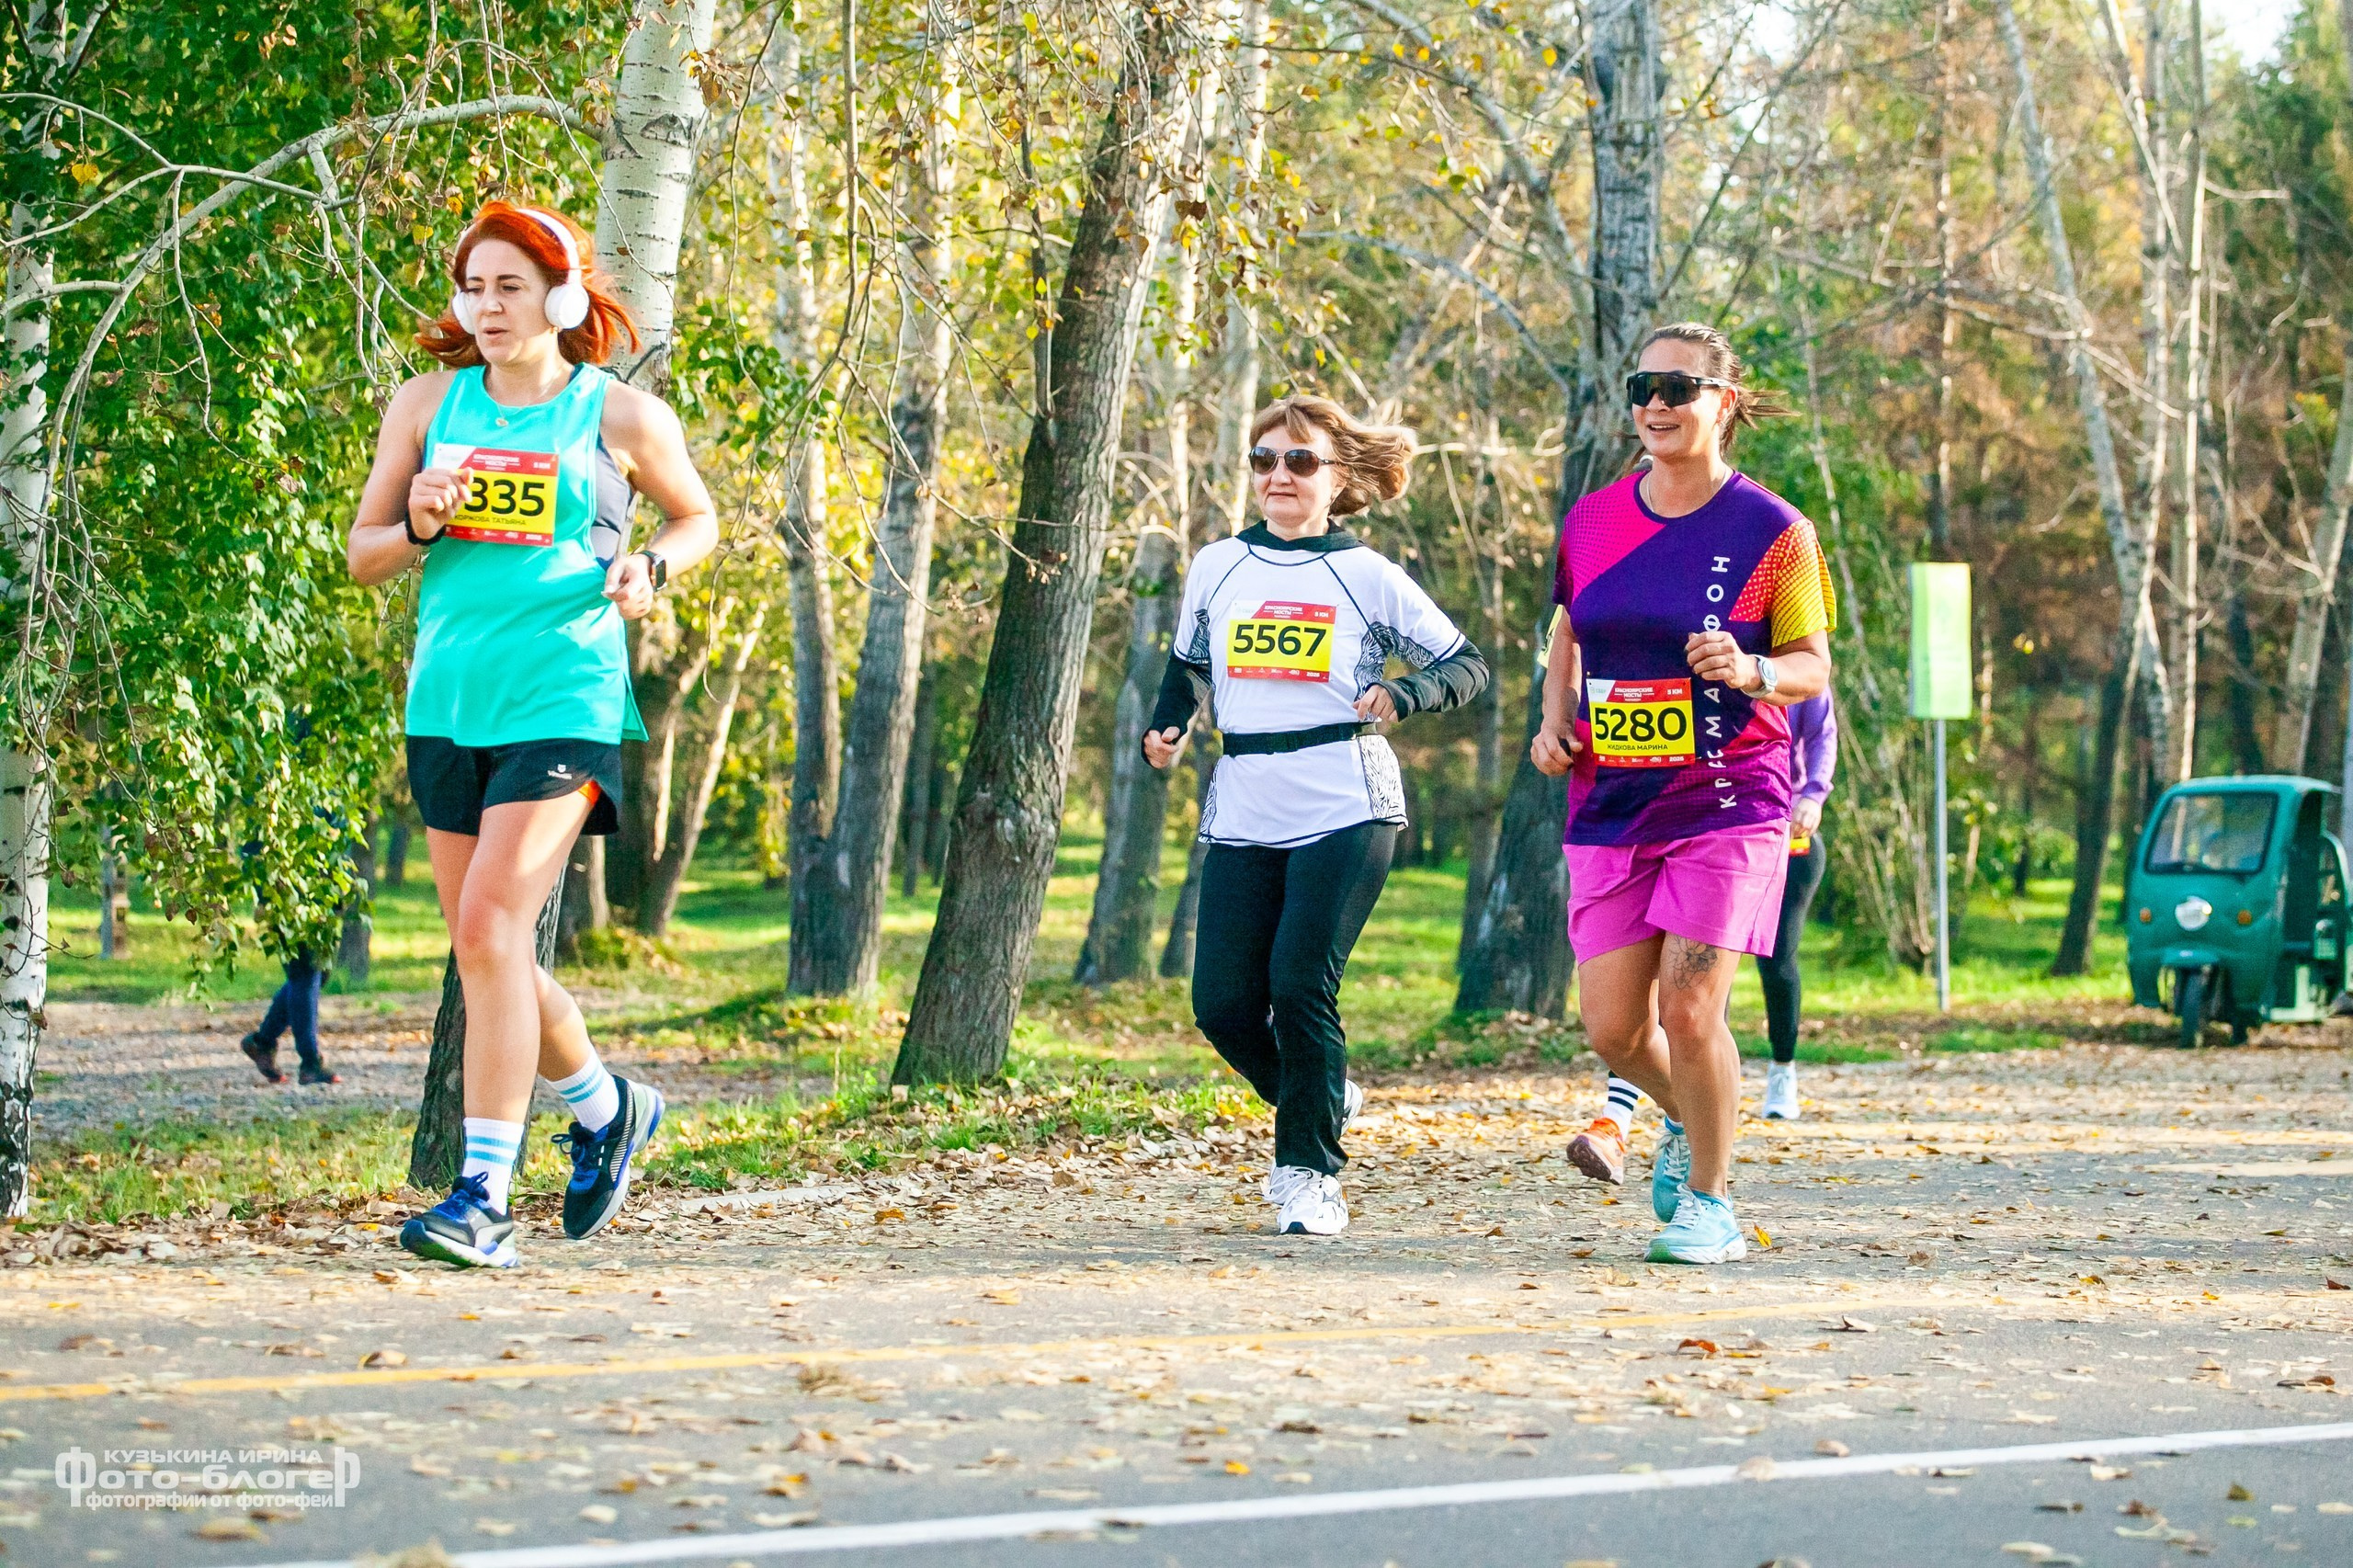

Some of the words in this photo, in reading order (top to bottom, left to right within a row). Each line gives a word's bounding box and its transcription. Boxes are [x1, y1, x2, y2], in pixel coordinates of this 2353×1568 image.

[464, 476, 545, 517] 335
[1233, 624, 1326, 657] 5567
[1595, 707, 1688, 743] 5280
